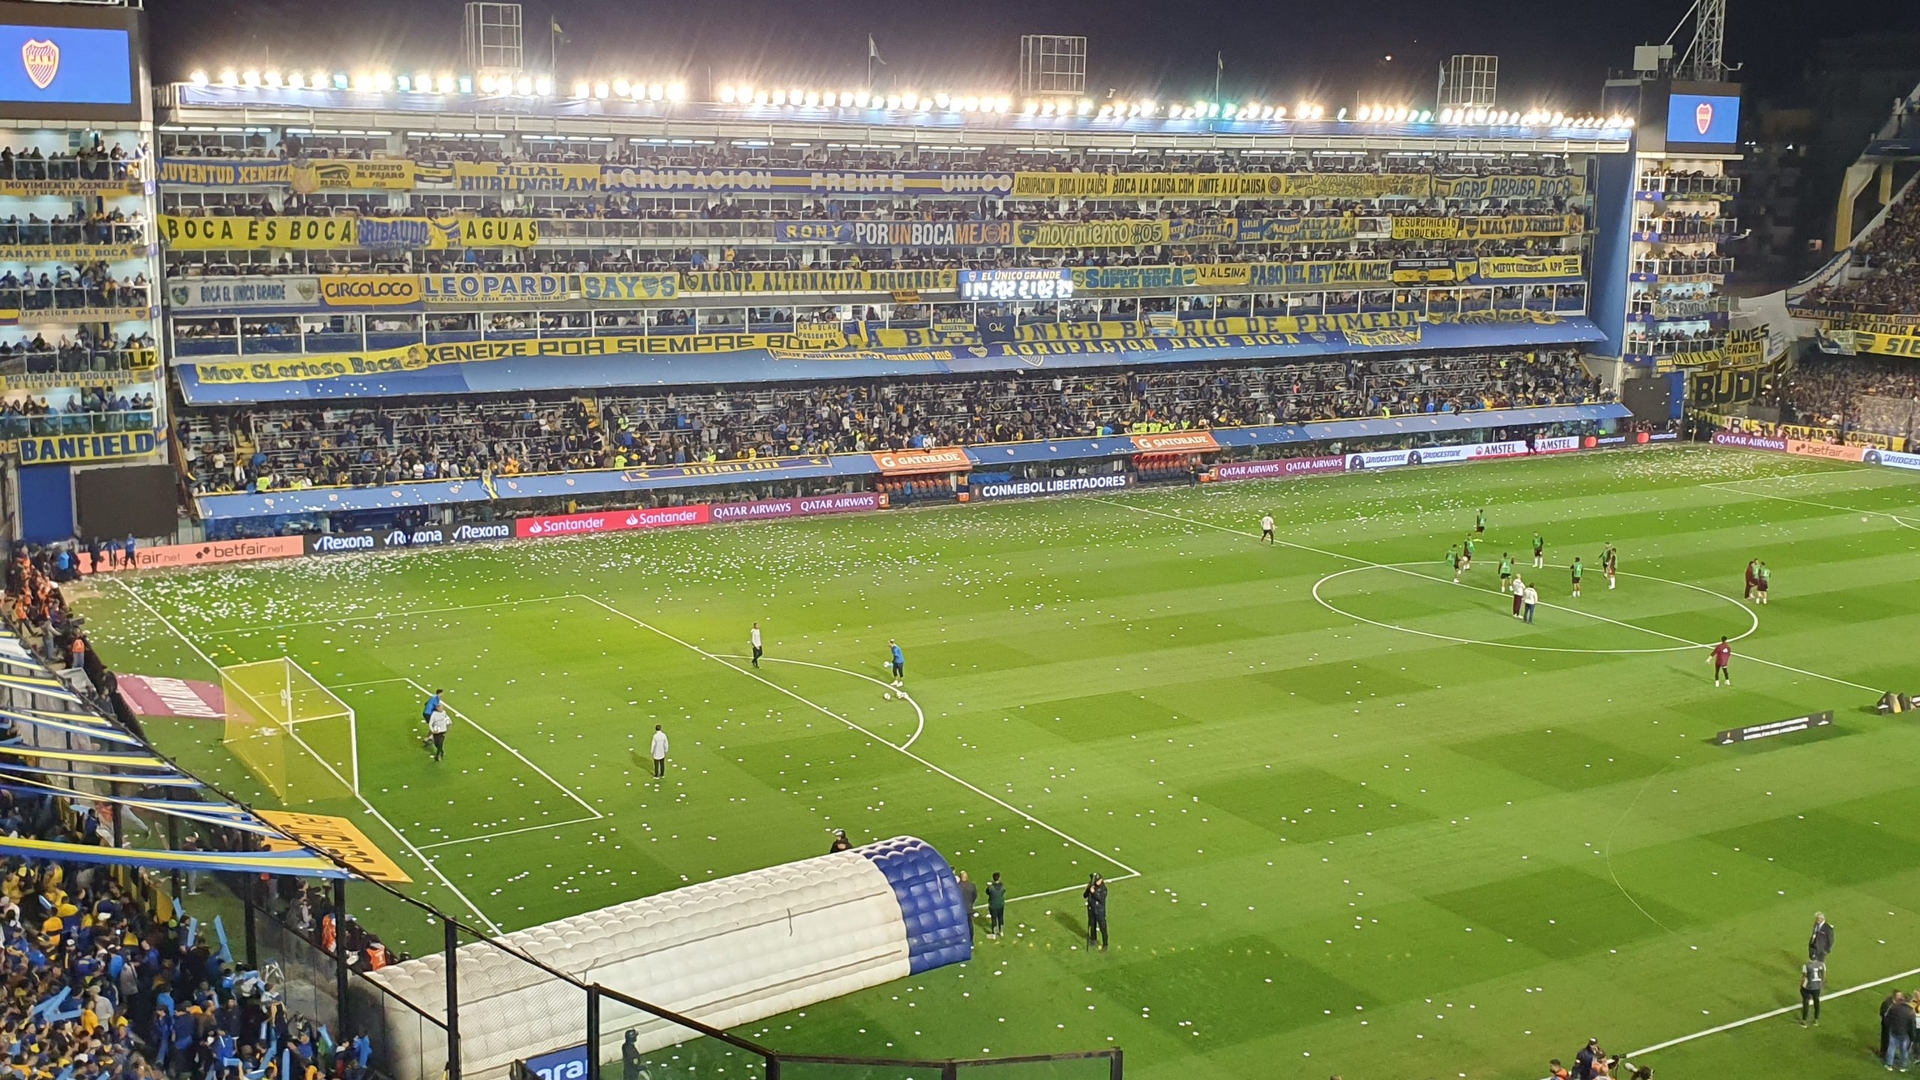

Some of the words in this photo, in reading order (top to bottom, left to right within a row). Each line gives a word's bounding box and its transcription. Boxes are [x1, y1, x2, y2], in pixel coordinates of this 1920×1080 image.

[160, 162, 234, 184] JUVENTUD
[496, 165, 563, 177] FILIAL
[5, 181, 76, 190] MOVIMIENTO
[79, 181, 124, 190] XENEIZE
[460, 176, 598, 192] HURLINGHAM
[605, 169, 771, 190] AGRUPACION
[811, 172, 905, 192] FRENTE
[941, 174, 1013, 193] UNICO
[1058, 177, 1076, 194] BOCA
[1077, 178, 1086, 194] LA
[1086, 176, 1108, 194] CAUSA
[1112, 177, 1136, 194] BOCA
[1139, 177, 1149, 194] LA
[1221, 178, 1227, 194] A
[1228, 178, 1238, 194] LA
[1240, 178, 1266, 194] CAUSA
[1538, 177, 1570, 196] BOCA
[167, 218, 233, 239] BOCA
[248, 220, 276, 241] ES
[290, 220, 352, 242] BOCA
[466, 220, 538, 242] AGUAS
[786, 224, 843, 239] RONY
[1480, 219, 1524, 235] LEALTAD
[76, 249, 91, 257] DE
[95, 249, 128, 257] BOCA
[981, 272, 992, 281] EL
[995, 270, 1023, 280] ÚNICO
[1024, 271, 1061, 280] GRANDE
[1086, 268, 1139, 289] SUPER
[1142, 268, 1184, 287] BOCA
[1251, 265, 1283, 286] PASO
[1285, 265, 1307, 284] DEL
[1308, 264, 1333, 284] REY
[1334, 262, 1355, 281] ISLA
[424, 275, 567, 297] LEOPARDI
[763, 272, 863, 291] ALTERNATIVA
[870, 271, 939, 288] BOQUENSE
[201, 285, 221, 302] BOCA
[222, 285, 231, 301] EL
[233, 284, 256, 301] UNICO
[325, 281, 412, 298] CIRCOLOCO
[1246, 316, 1279, 333] DE
[1297, 312, 1418, 332] PRIMERA
[426, 342, 527, 362] XENEIZE
[538, 338, 605, 356] POR
[617, 335, 755, 353] SIEMPRE
[1002, 337, 1158, 356] AGRUPACION
[1169, 335, 1231, 350] DALE
[1240, 333, 1300, 346] BOCA
[5, 372, 76, 383] MOVIMIENTO
[79, 371, 133, 381] BOQUENSE
[21, 433, 155, 462] BANFIELD
[1153, 435, 1208, 448] GATORADE
[1484, 443, 1517, 455] AMSTEL
[1540, 438, 1572, 450] AMSTEL
[1717, 434, 1746, 446] QATAR
[1748, 437, 1785, 450] AIRWAYS
[898, 452, 960, 466] GATORADE
[1285, 462, 1310, 472] QATAR
[1312, 458, 1342, 470] AIRWAYS
[1220, 467, 1247, 478] QATAR
[1248, 463, 1279, 475] AIRWAYS
[982, 482, 1046, 497] CONMEBOL
[1047, 475, 1126, 492] LIBERTADORES
[713, 506, 747, 519] QATAR
[750, 502, 791, 515] AIRWAYS
[801, 499, 833, 512] QATAR
[835, 496, 874, 509] AIRWAYS
[544, 518, 604, 533] Santander
[639, 511, 697, 525] Santander
[462, 524, 509, 539] Rexona
[323, 535, 374, 550] Rexona
